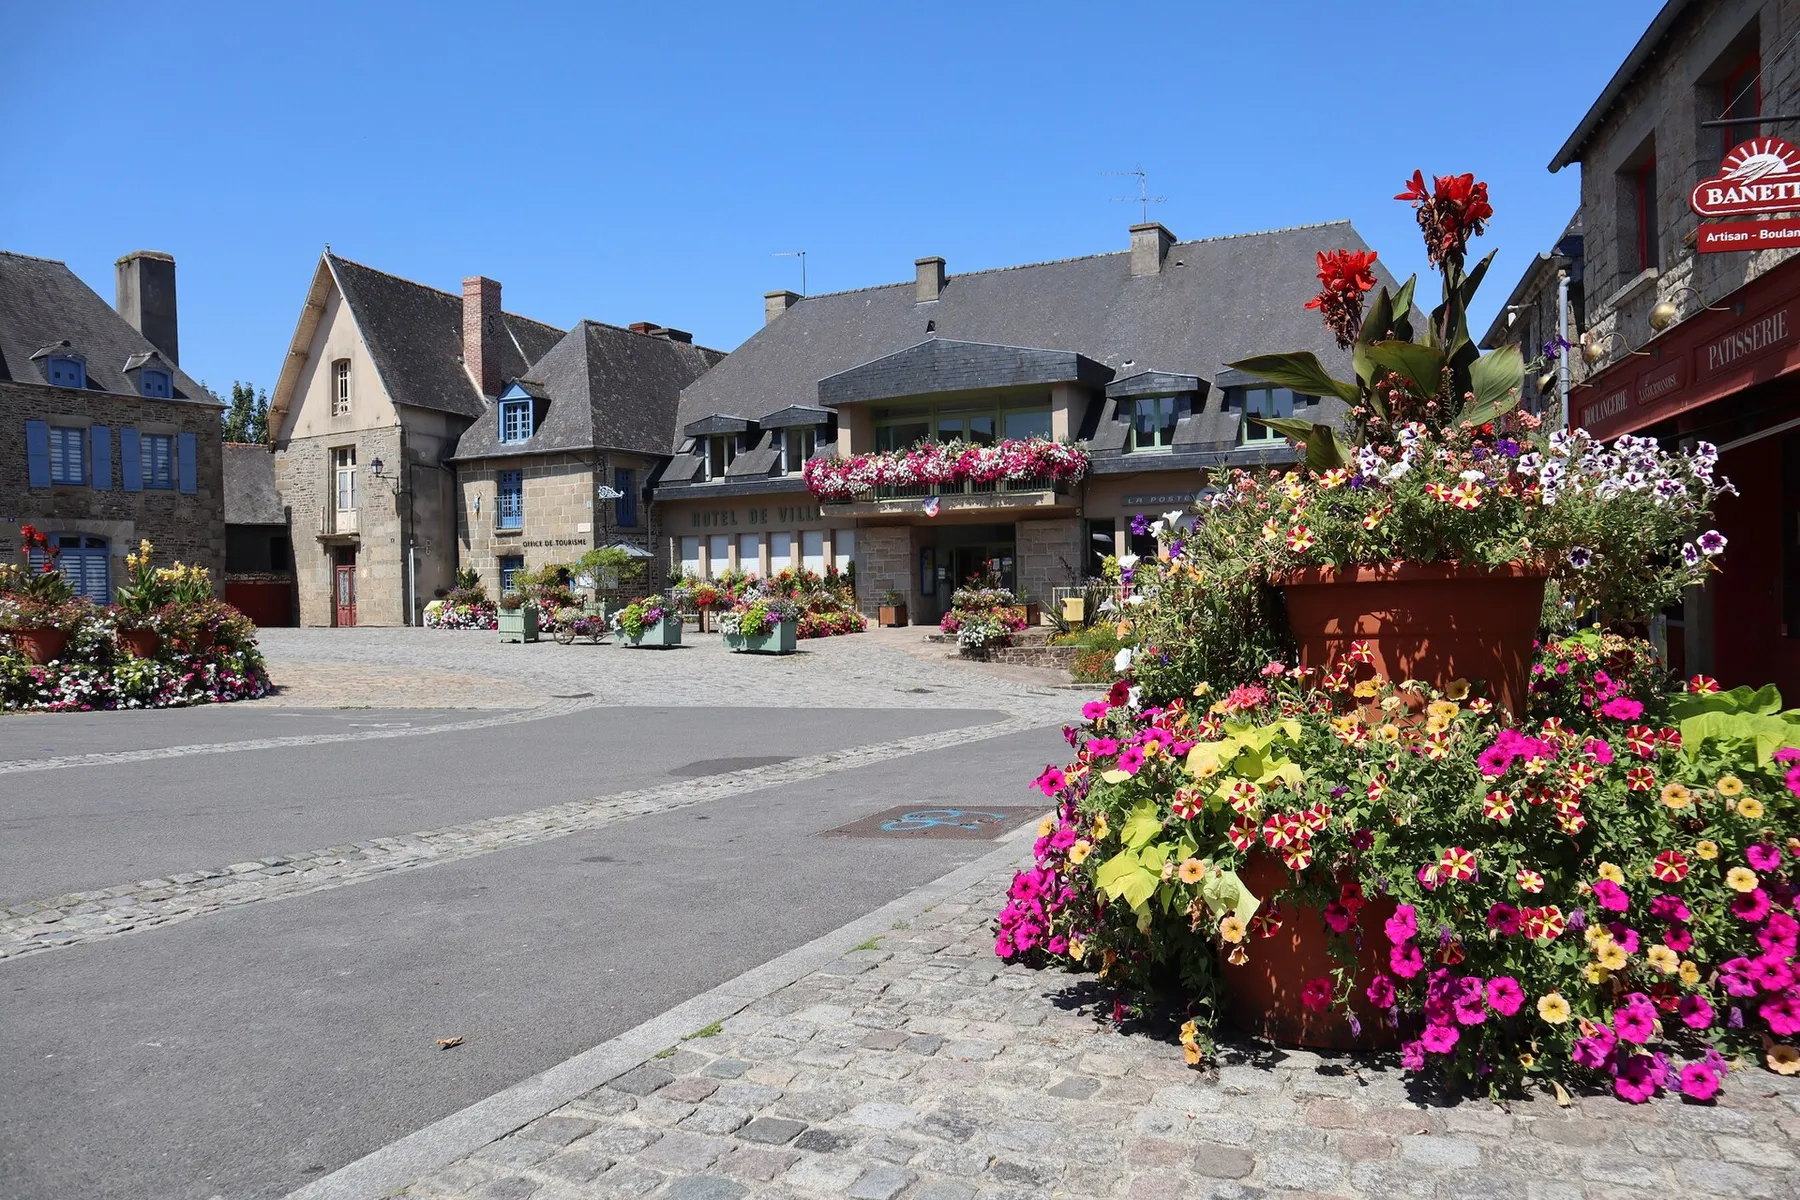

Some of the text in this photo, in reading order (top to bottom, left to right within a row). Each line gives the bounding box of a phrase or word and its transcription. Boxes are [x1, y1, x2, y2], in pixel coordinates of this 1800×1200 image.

[1706, 231, 1748, 242] Artisan
[1709, 309, 1788, 370] PATISSERIE
[1584, 390, 1628, 427] BOULANGERIE
[691, 509, 738, 527] HOTEL
[749, 508, 767, 524] DE
[522, 540, 542, 548] OFFICE
